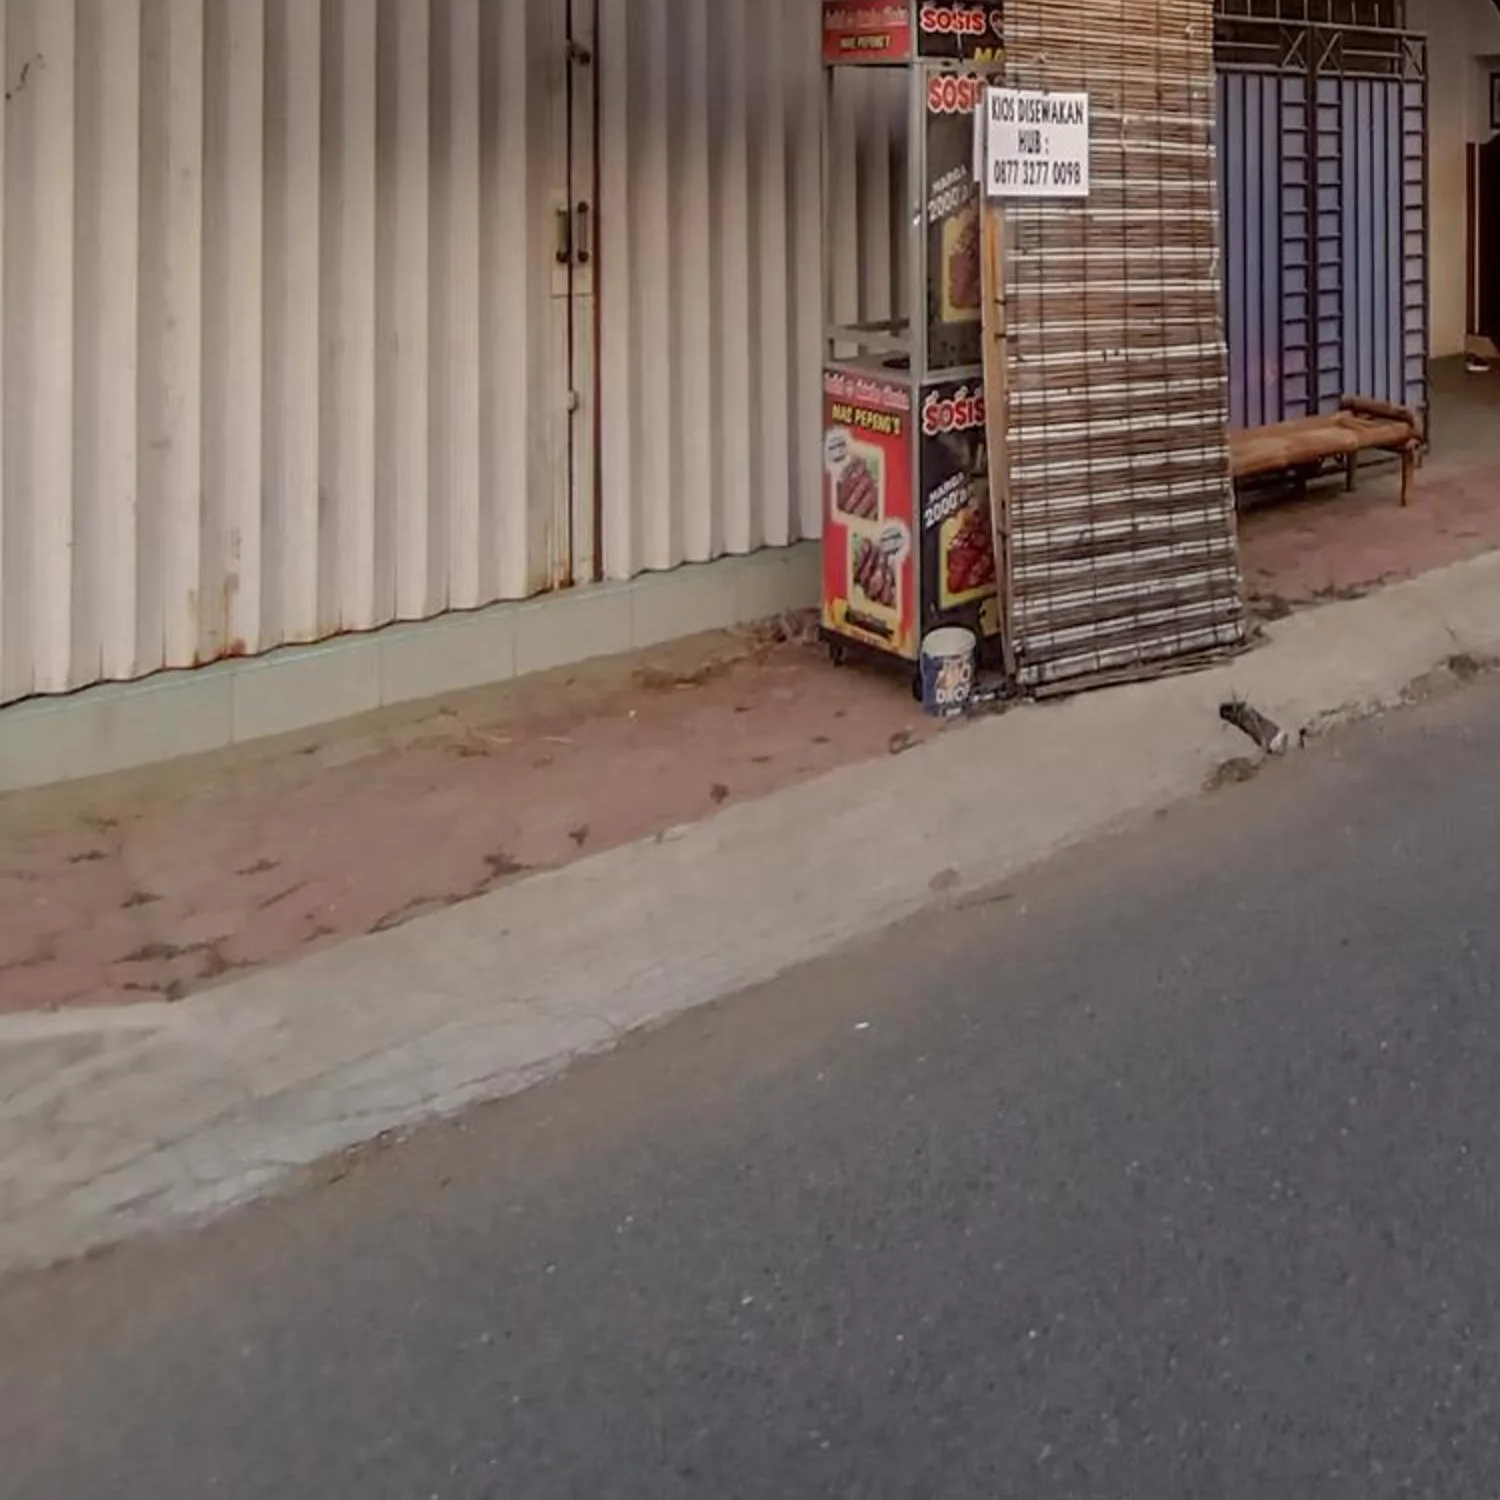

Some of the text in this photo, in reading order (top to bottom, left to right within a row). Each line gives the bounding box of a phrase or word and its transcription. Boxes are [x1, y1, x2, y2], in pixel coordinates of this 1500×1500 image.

[921, 8, 986, 34] SOSIS
[992, 95, 1084, 125] KIOS DISEWAKAN
[1018, 129, 1041, 154] HUB
[994, 159, 1081, 186] 0877 3277 0098
